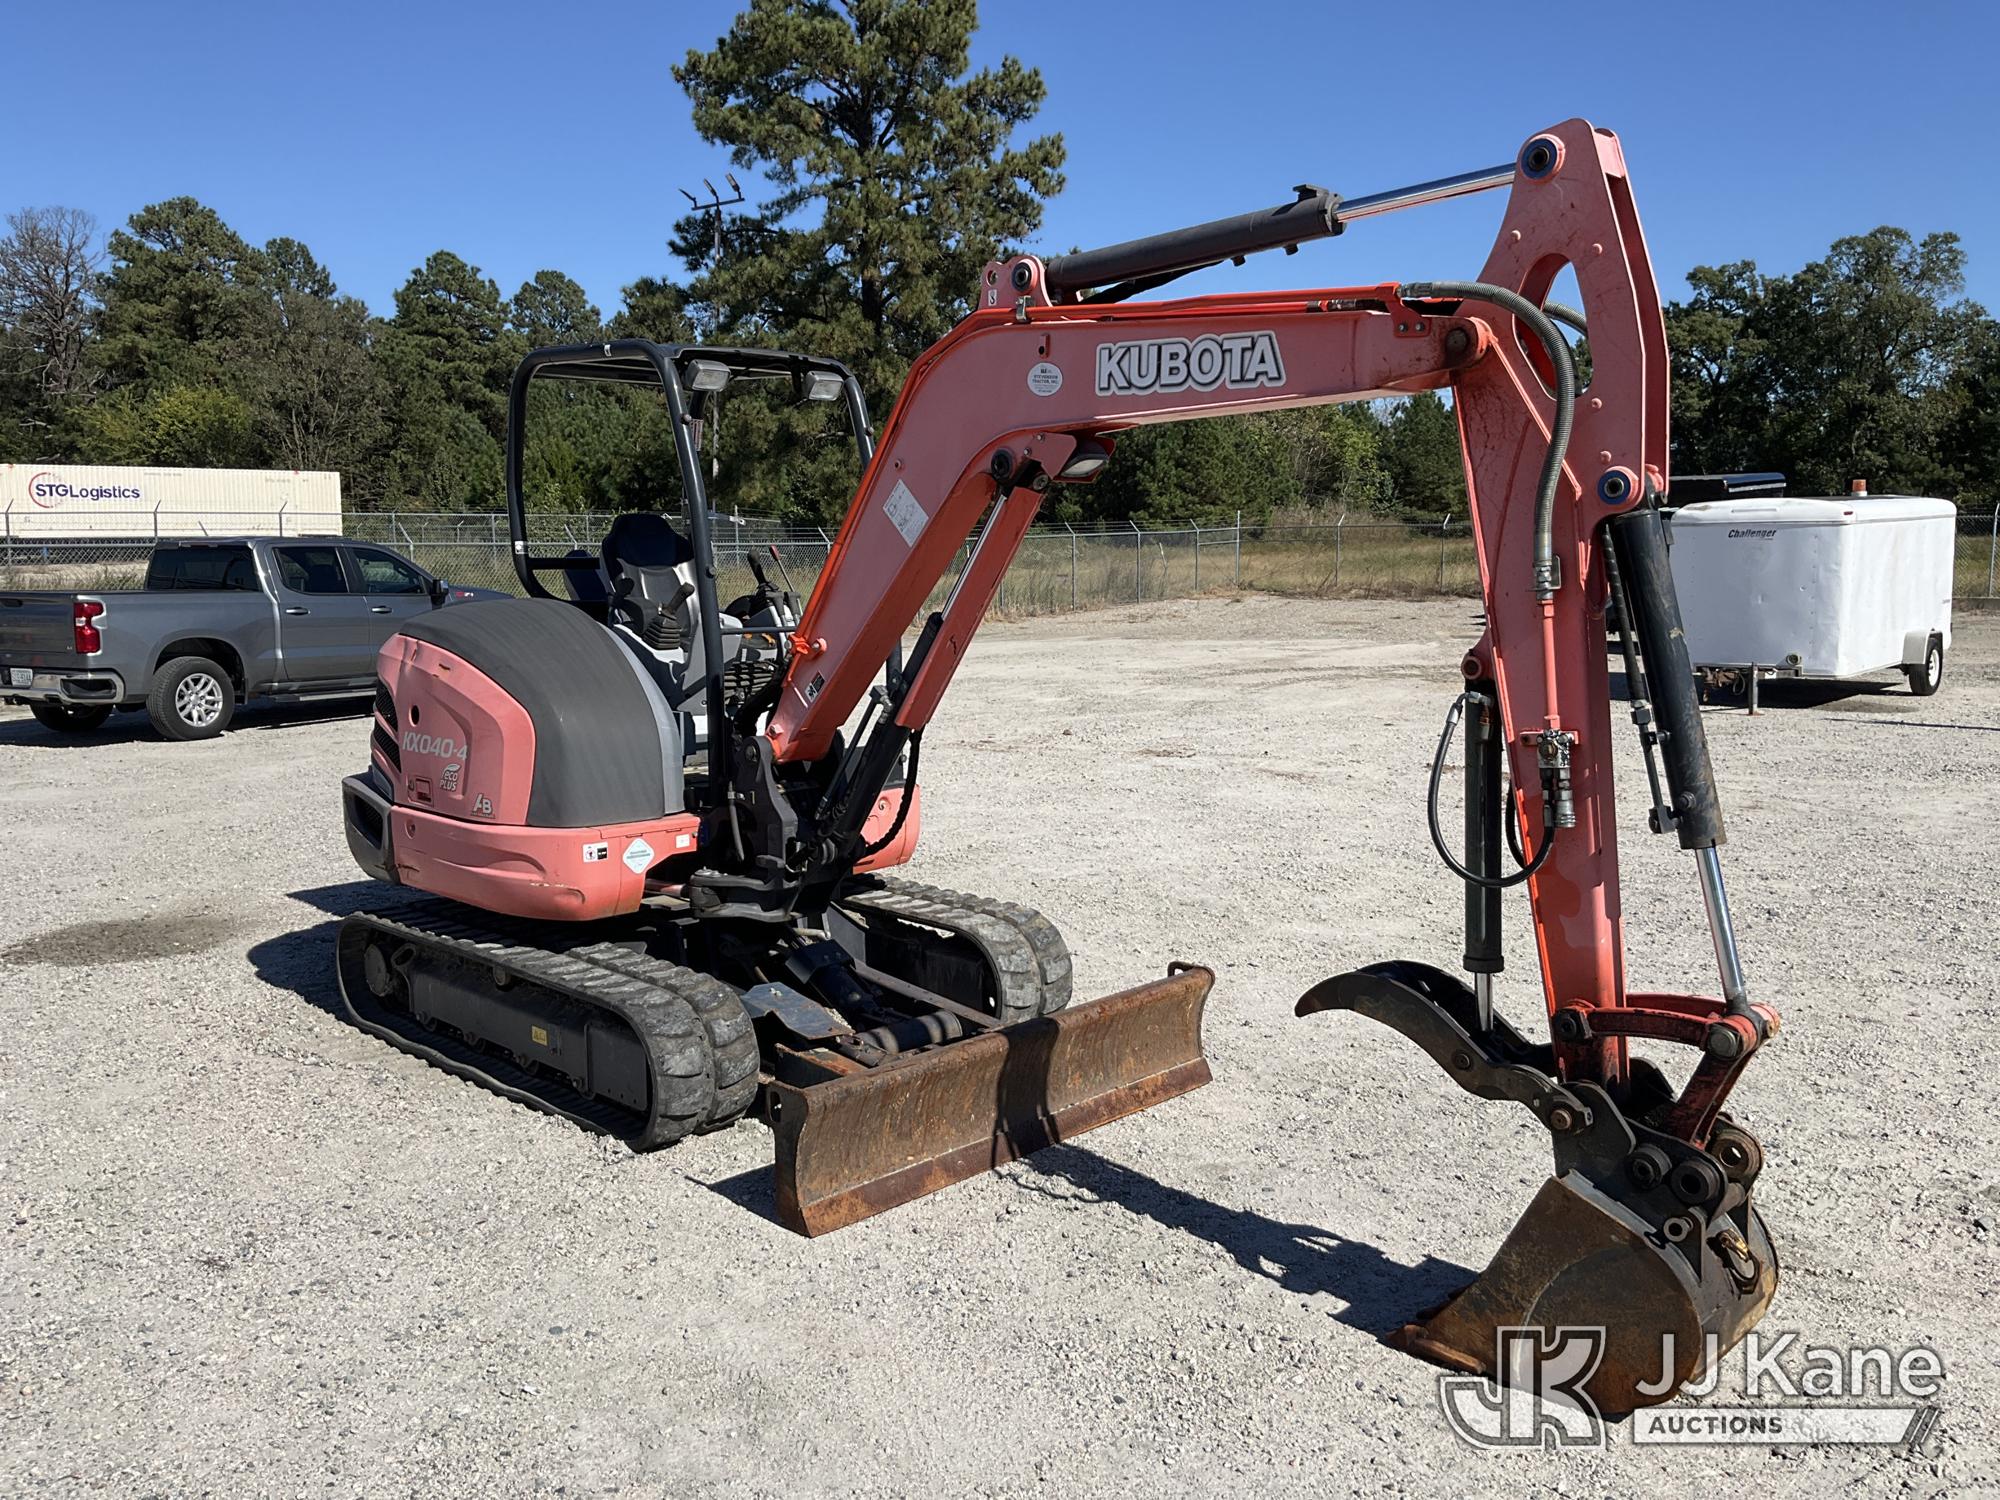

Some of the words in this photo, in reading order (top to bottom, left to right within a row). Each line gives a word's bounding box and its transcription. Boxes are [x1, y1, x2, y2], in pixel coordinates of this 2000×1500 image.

[1098, 335, 1281, 389] KUBOTA
[1728, 529, 1776, 539] Challenger
[402, 731, 468, 761] KX040-4
[444, 771, 458, 781] eco
[440, 779, 457, 791] PLUS
